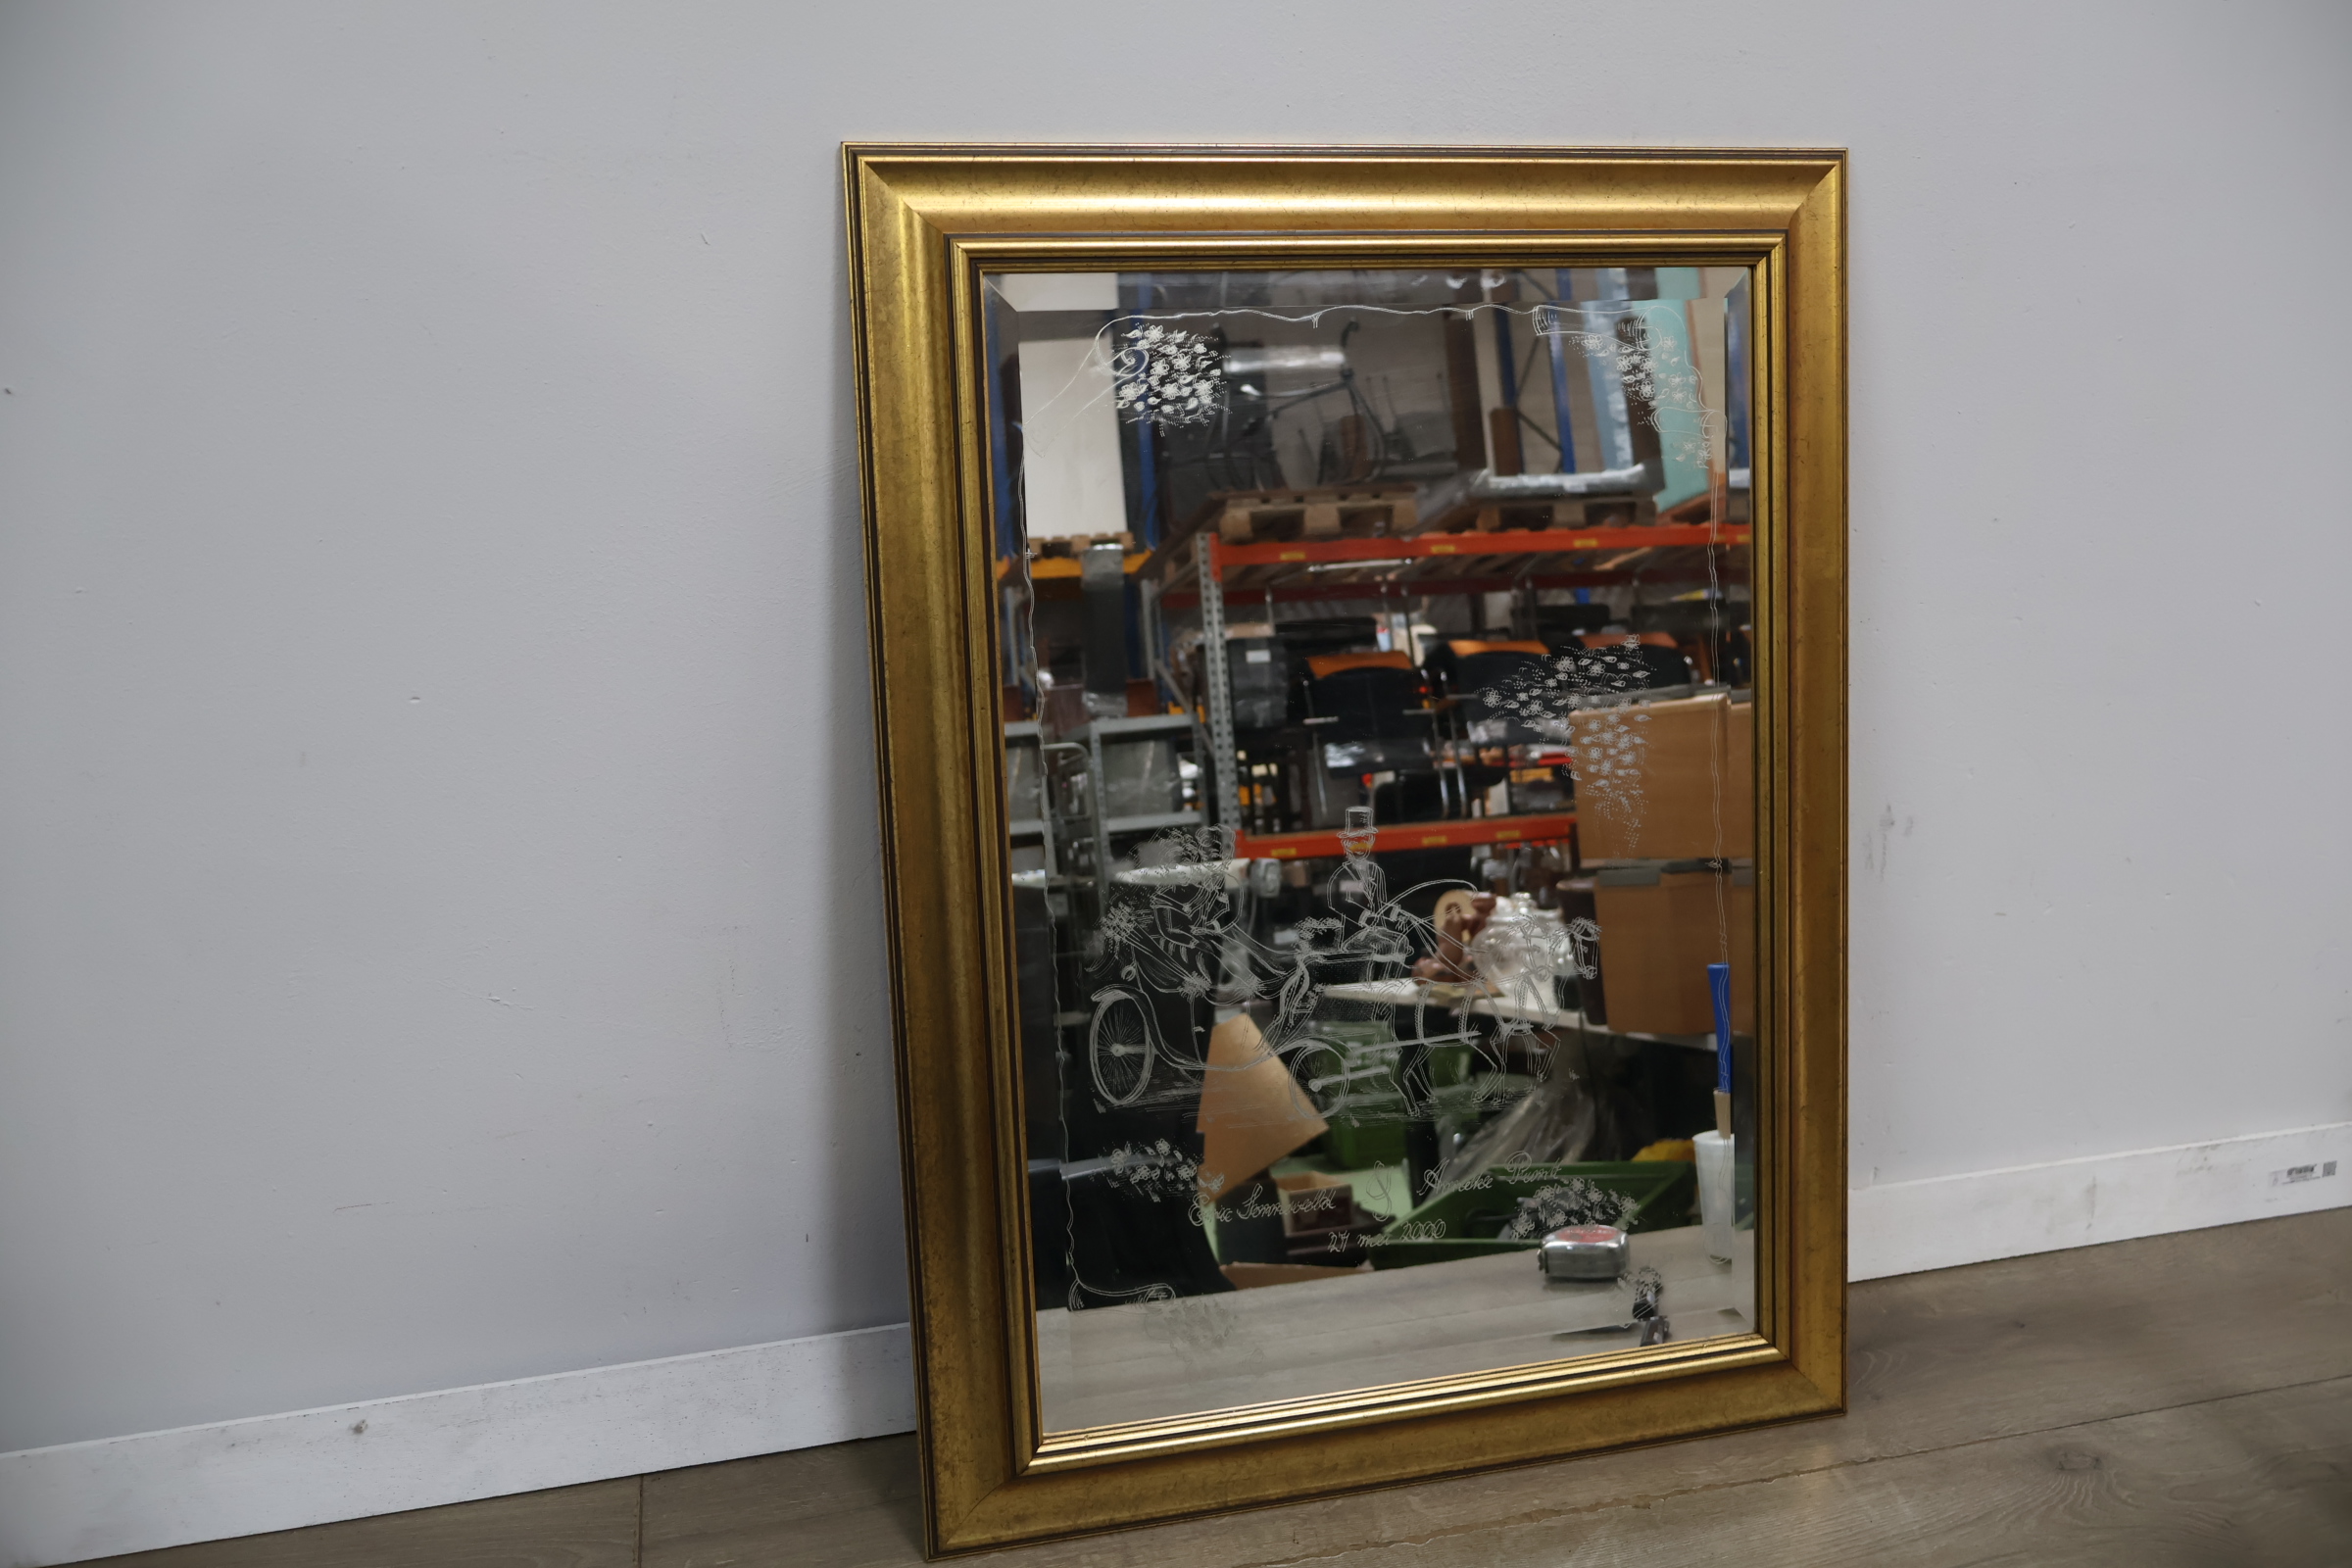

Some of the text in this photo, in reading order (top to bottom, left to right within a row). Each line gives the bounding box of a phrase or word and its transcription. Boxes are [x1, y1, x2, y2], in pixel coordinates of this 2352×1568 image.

[1416, 1157, 1493, 1196] Anneke
[1504, 1151, 1562, 1185] Punt
[1327, 1218, 1446, 1252] 27 mei 2000
